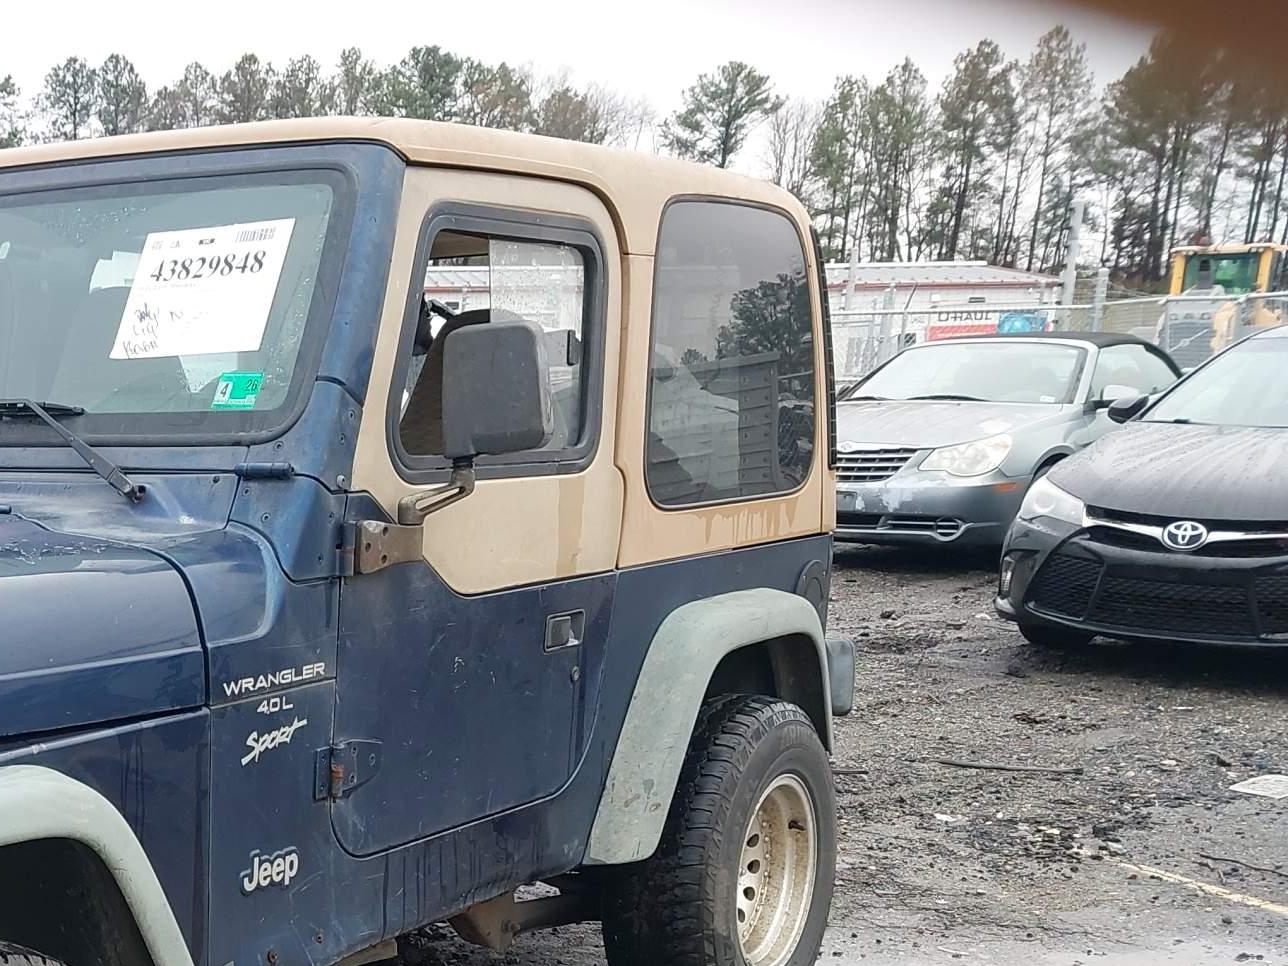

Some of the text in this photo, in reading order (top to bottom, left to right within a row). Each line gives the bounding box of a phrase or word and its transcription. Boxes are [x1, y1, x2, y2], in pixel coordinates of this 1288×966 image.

[150, 250, 266, 282] 43829848
[220, 382, 230, 397] 4
[223, 662, 325, 696] WRANGLER
[241, 715, 308, 766] Sport
[243, 853, 299, 891] Jeep
